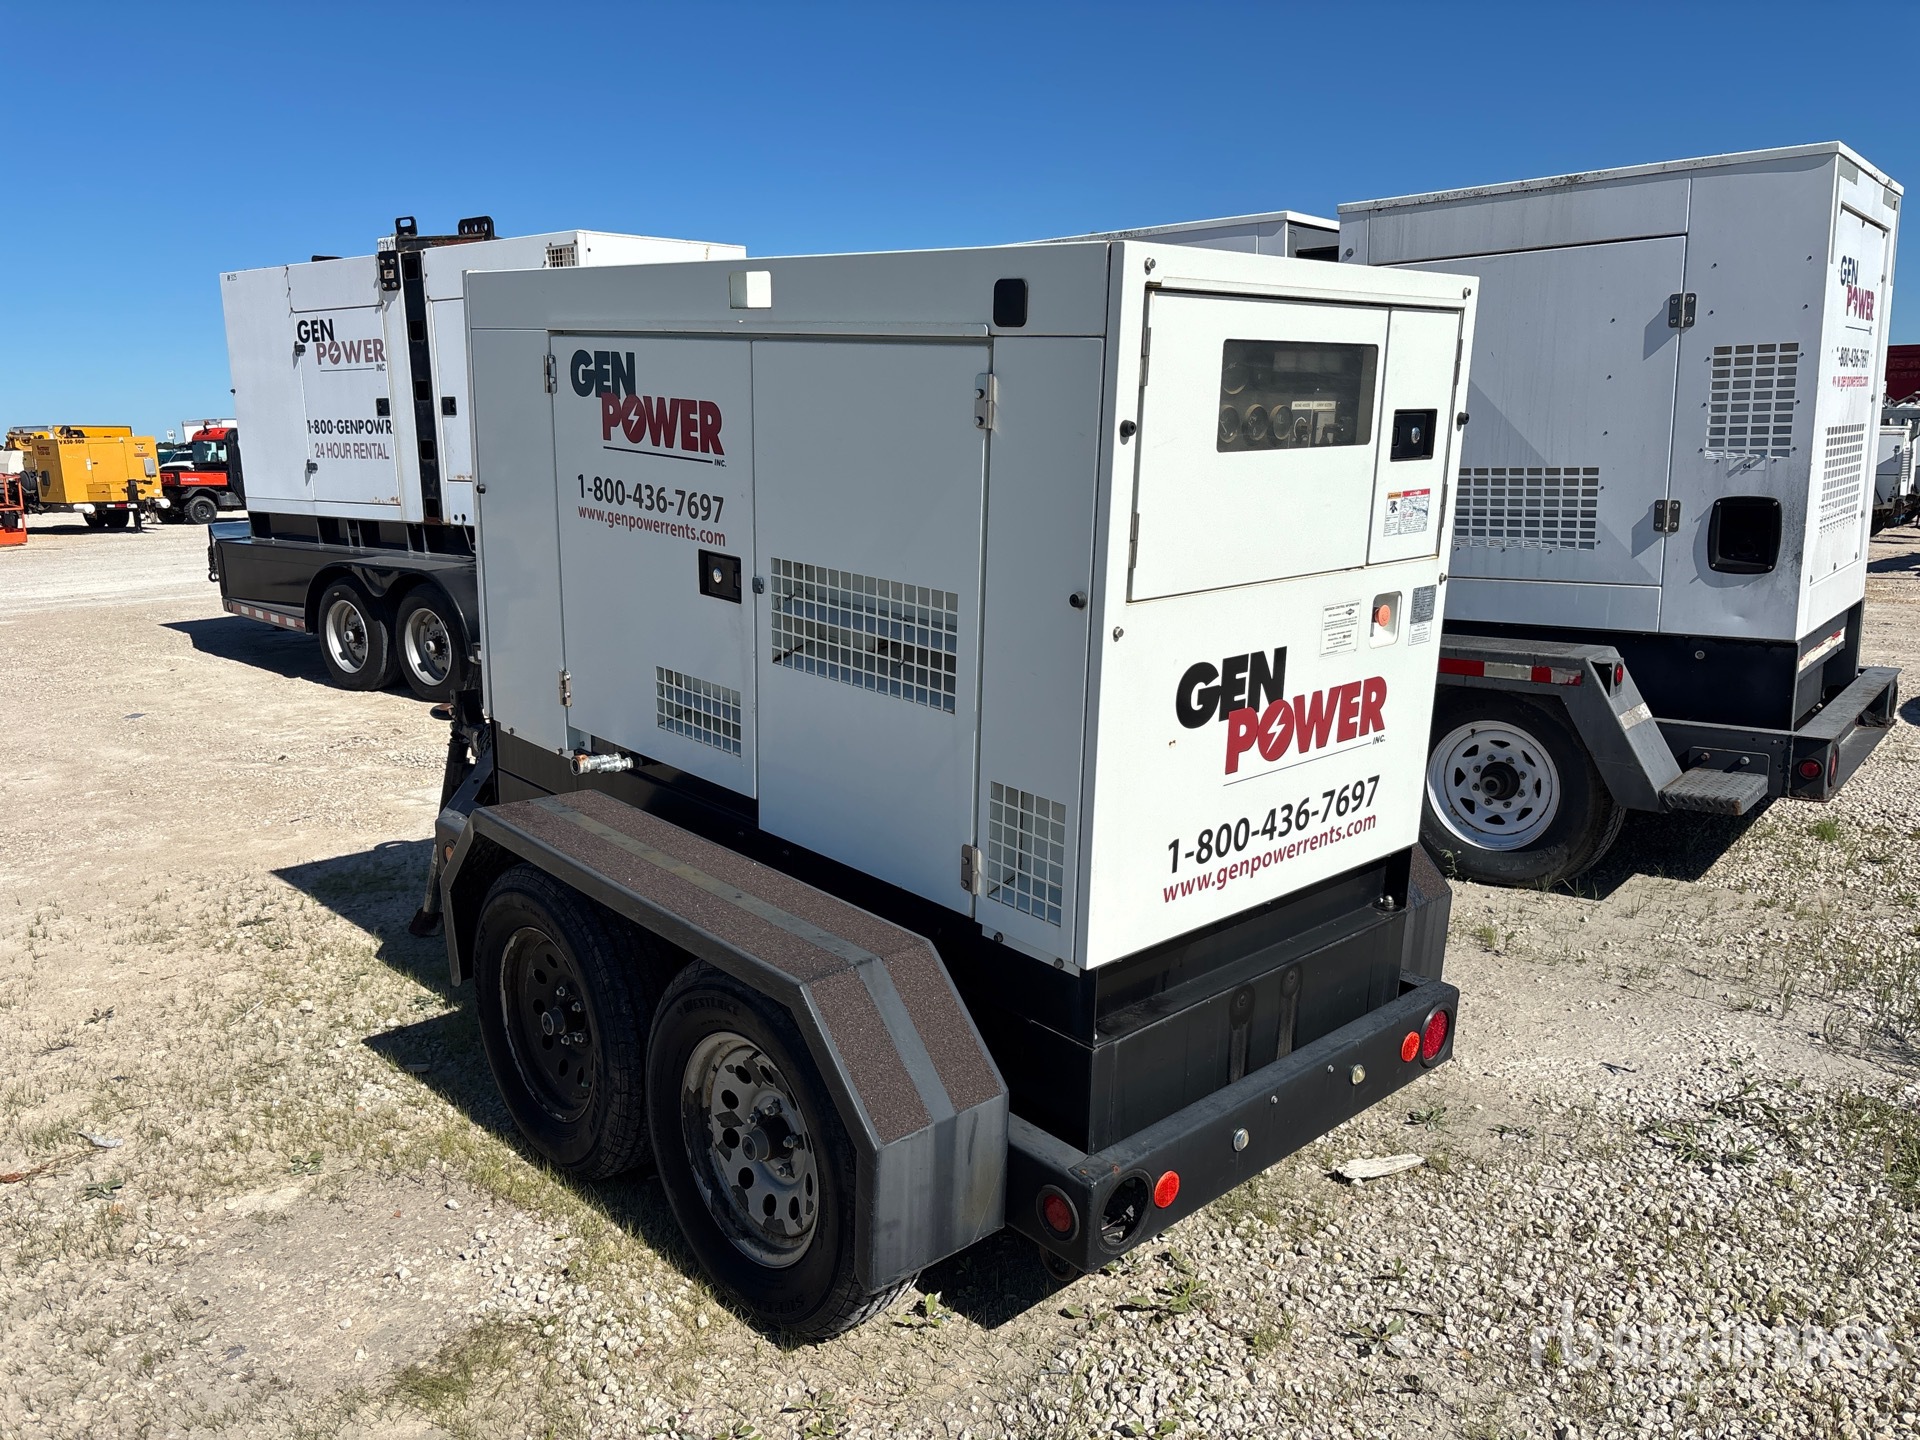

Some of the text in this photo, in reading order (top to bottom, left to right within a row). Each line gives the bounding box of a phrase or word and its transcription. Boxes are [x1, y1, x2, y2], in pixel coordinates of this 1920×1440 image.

[1840, 255, 1859, 287] GEN
[1846, 285, 1875, 322] POWER
[296, 318, 335, 343] GEN
[316, 338, 387, 366] POWER
[570, 349, 637, 400] GEN
[307, 419, 393, 435] 1-800-GENPOWR
[601, 391, 725, 456] POWER
[314, 442, 390, 460] 24 HOUR RENTAL
[714, 458, 727, 468] INC.
[577, 473, 725, 525] 1-800-436-7697
[577, 505, 726, 547] www.genpowerrents.com
[1175, 646, 1288, 729] GEN
[1225, 676, 1388, 775] POWER
[1372, 734, 1387, 746] INC.
[1167, 774, 1381, 874] 1-800-436-7697
[1162, 814, 1377, 904] www.genpowerrents.com
